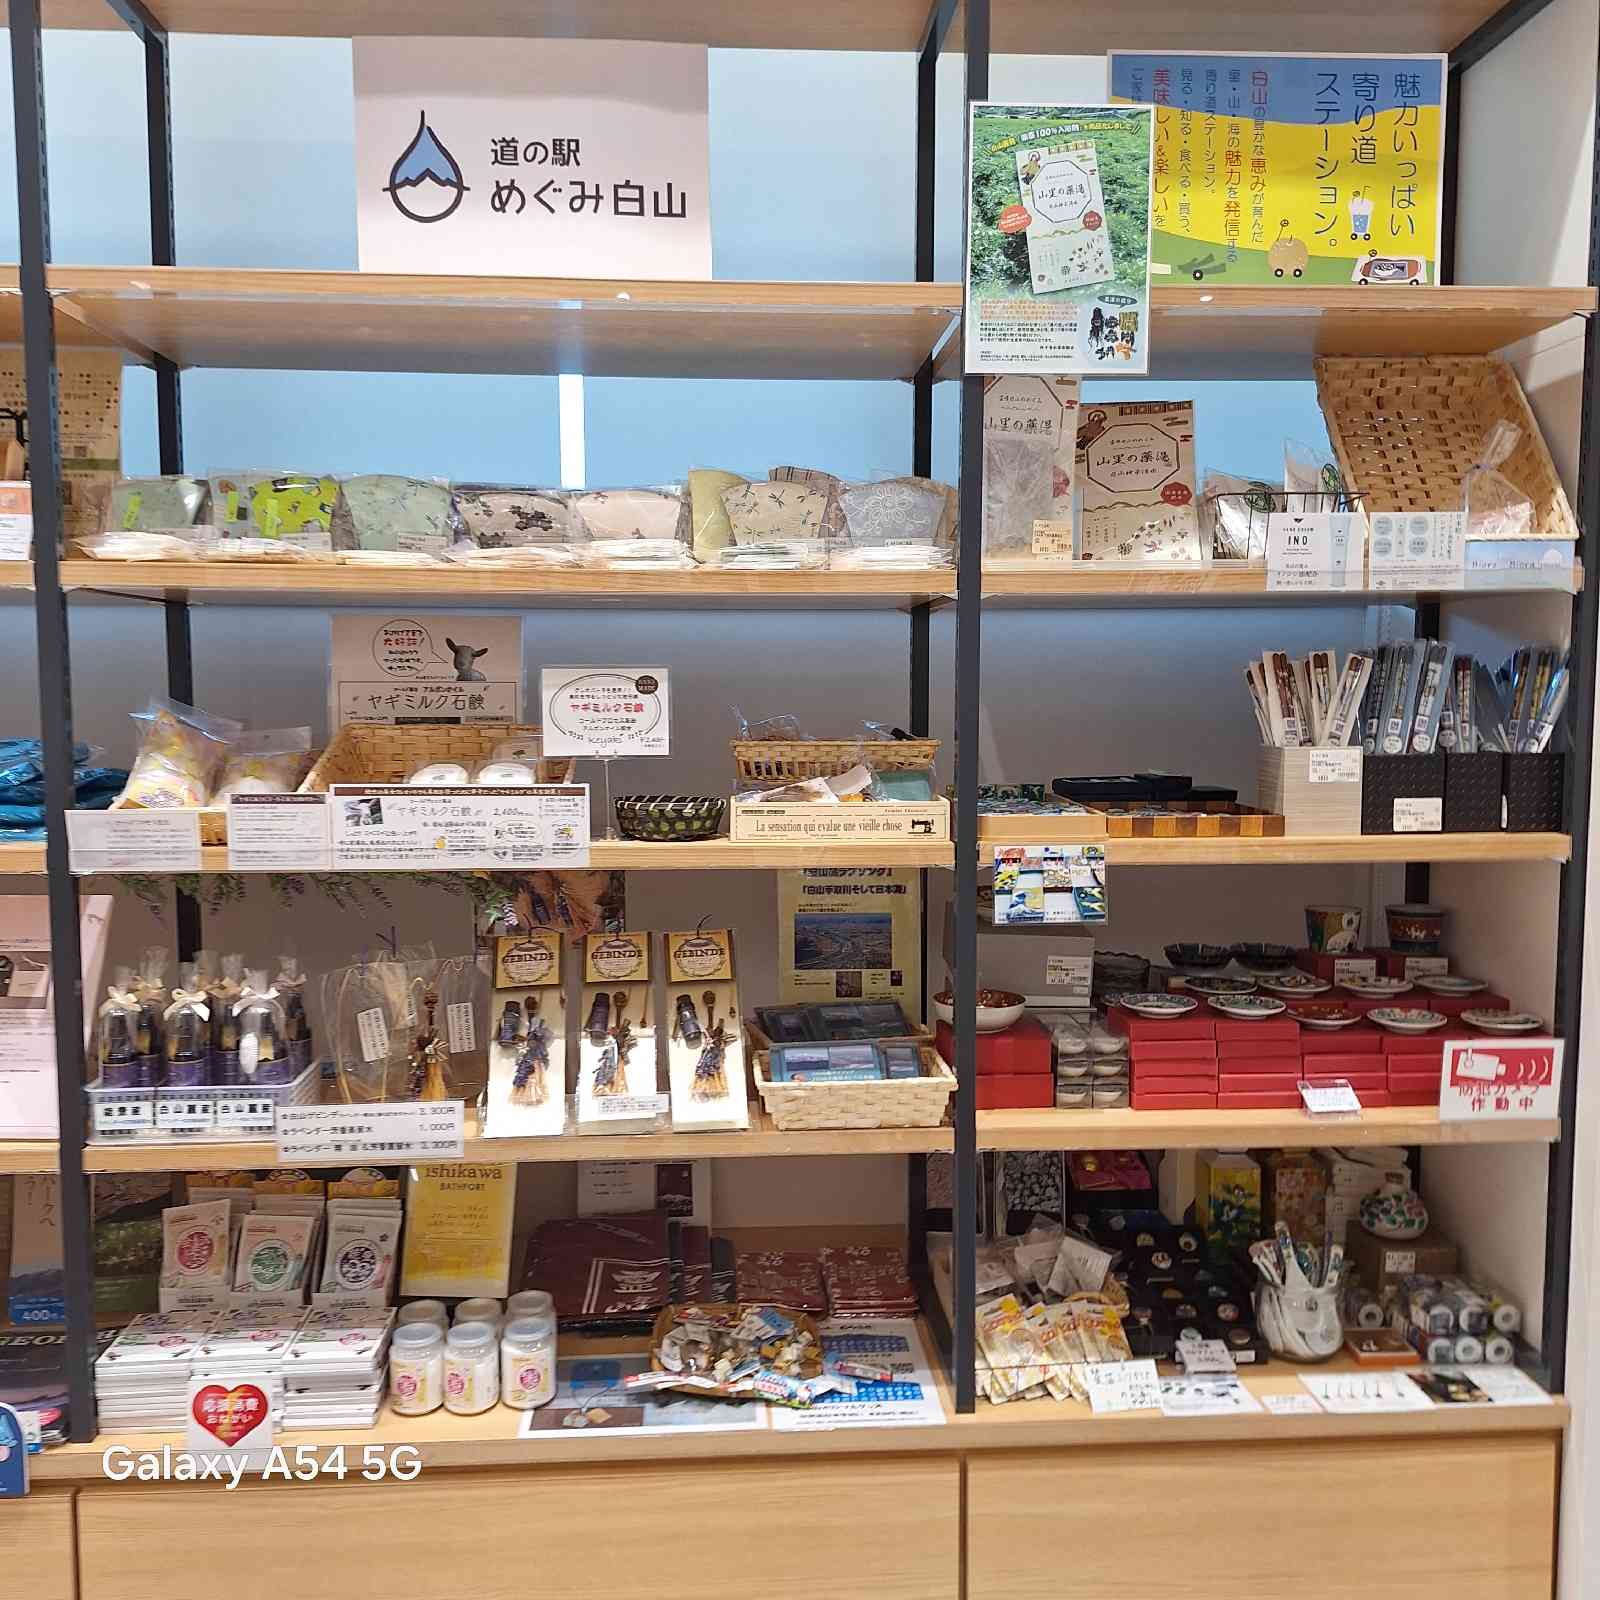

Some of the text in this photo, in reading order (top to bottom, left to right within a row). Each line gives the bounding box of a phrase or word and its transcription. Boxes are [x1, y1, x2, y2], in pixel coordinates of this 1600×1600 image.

[1350, 72, 1378, 165] 寄り道
[491, 138, 580, 168] 道の駅
[1314, 72, 1342, 247] ステーション。
[1390, 73, 1421, 238] 魅力いっぱい
[491, 179, 687, 219] めぐみ白山
[1096, 450, 1171, 466] 山里の薬湯
[1287, 535, 1308, 546] INO
[367, 693, 487, 711] ヤギミルク石鹸
[569, 702, 644, 713] ヤギミルク石鹸
[755, 818, 903, 834] La sensation qui evalue une vieille chose
[1472, 1097, 1534, 1113] 作動中
